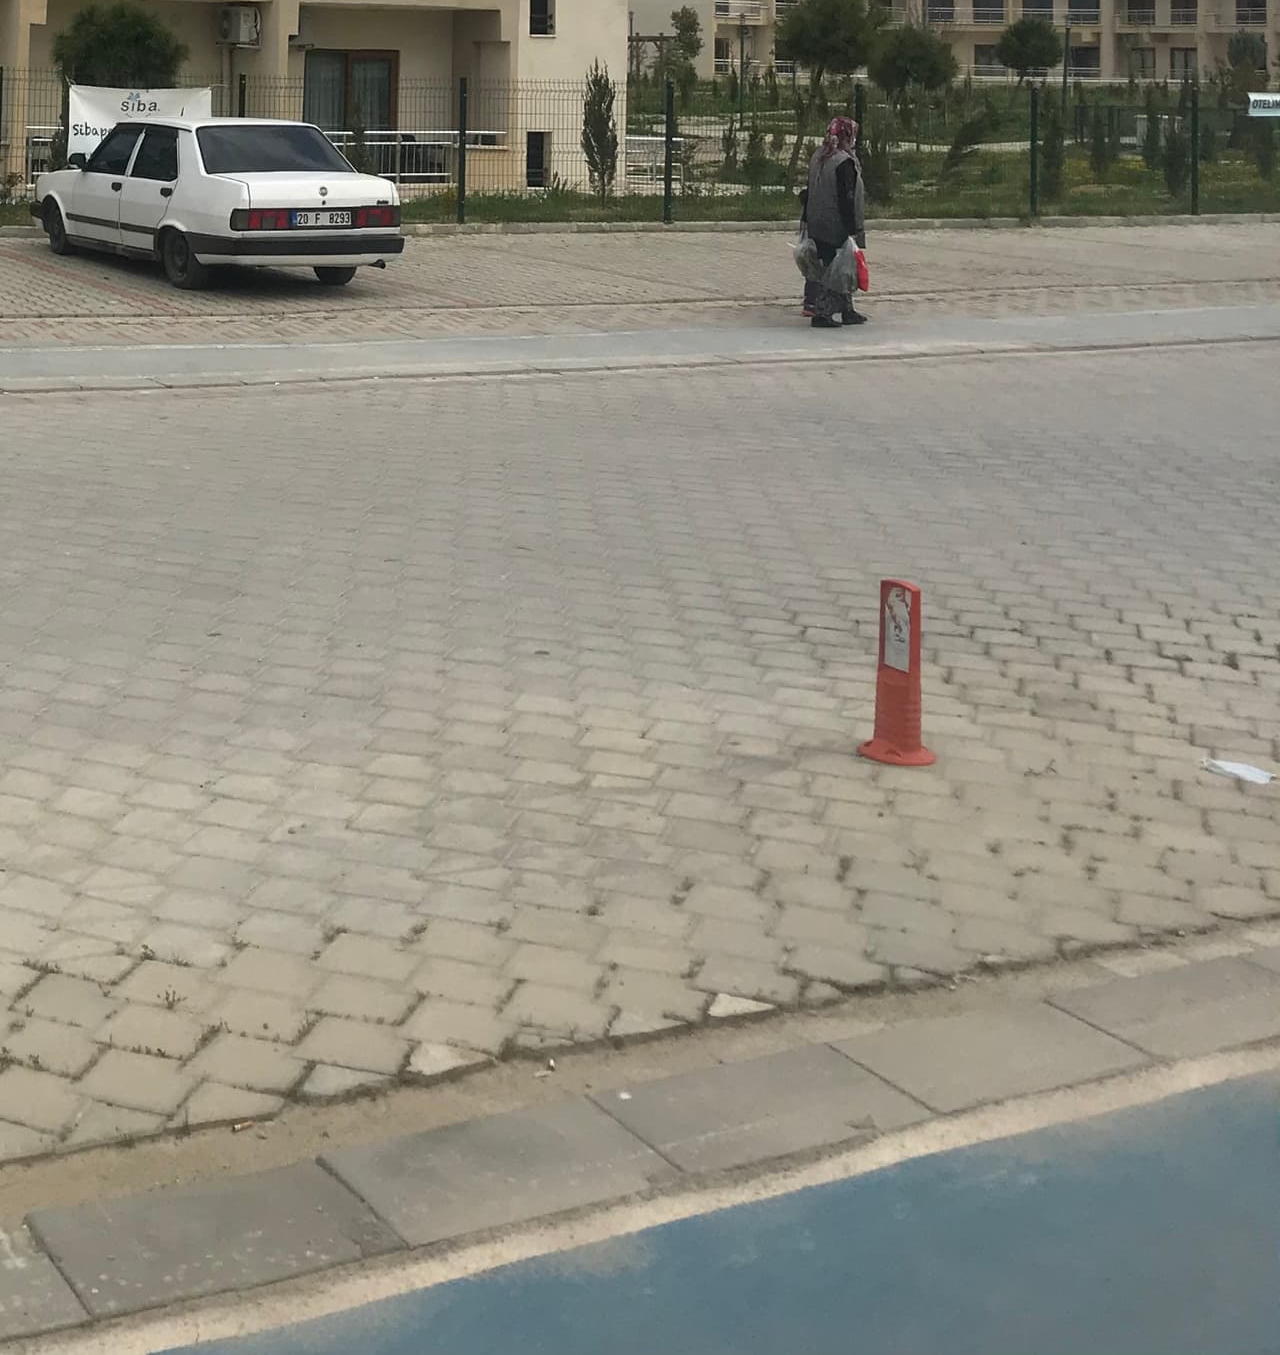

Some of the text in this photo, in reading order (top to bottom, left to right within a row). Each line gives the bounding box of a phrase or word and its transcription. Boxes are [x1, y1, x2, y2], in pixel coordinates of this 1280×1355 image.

[298, 213, 351, 225] 20 F 8293
